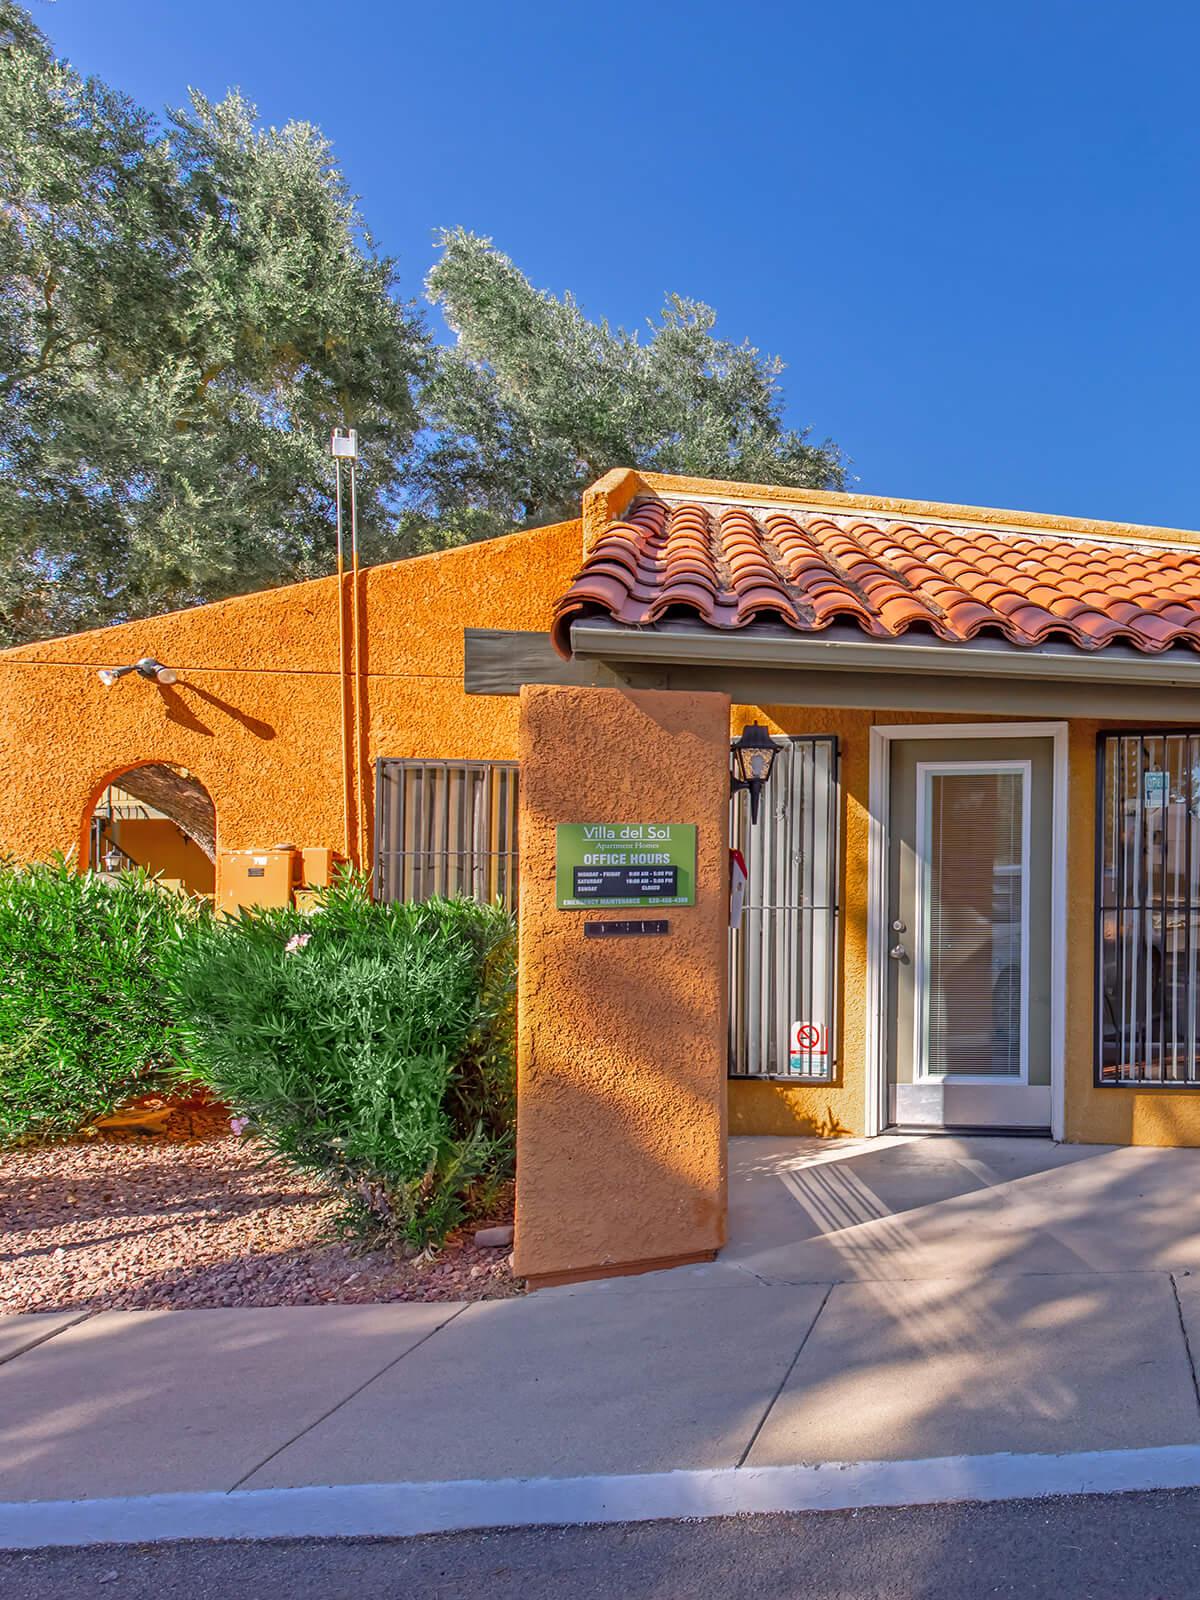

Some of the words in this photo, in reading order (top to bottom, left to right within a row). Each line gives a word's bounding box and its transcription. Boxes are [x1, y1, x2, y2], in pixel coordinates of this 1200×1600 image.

[584, 826, 615, 839] Villa
[620, 826, 643, 839] del
[648, 826, 670, 839] Sol
[596, 843, 633, 851] Apartment
[584, 854, 626, 864] OFFICE
[630, 853, 670, 864] HOURS
